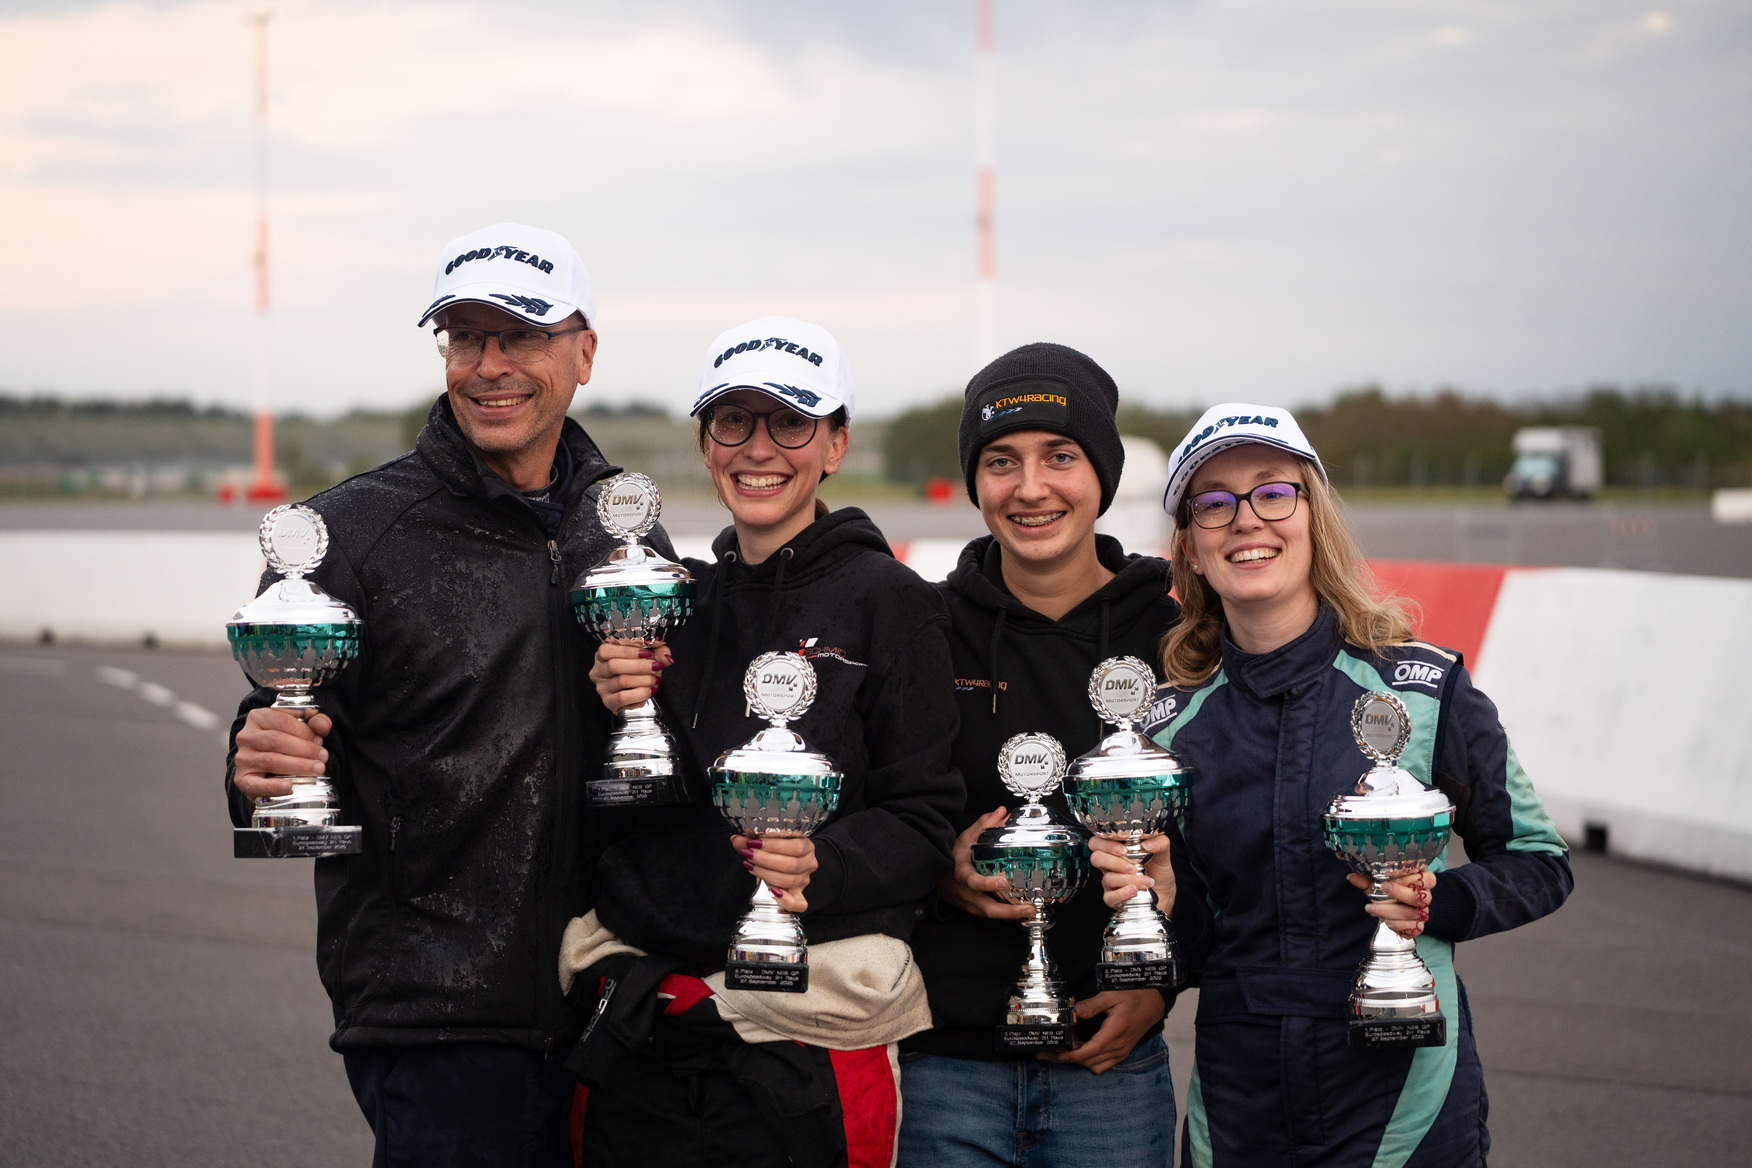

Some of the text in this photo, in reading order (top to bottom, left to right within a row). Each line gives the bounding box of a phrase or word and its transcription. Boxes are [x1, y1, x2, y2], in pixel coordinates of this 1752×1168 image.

[445, 245, 554, 275] GOODYEAR
[713, 337, 823, 368] GOODYEAR
[995, 393, 1067, 407] KTW4Racing
[612, 494, 643, 506] DMV
[805, 646, 847, 658] SCHMID
[761, 672, 798, 685] DMV
[1394, 663, 1443, 682] OMP
[1105, 678, 1138, 691] DMV
[1365, 713, 1394, 726] DMV
[1015, 752, 1049, 765] DMV
